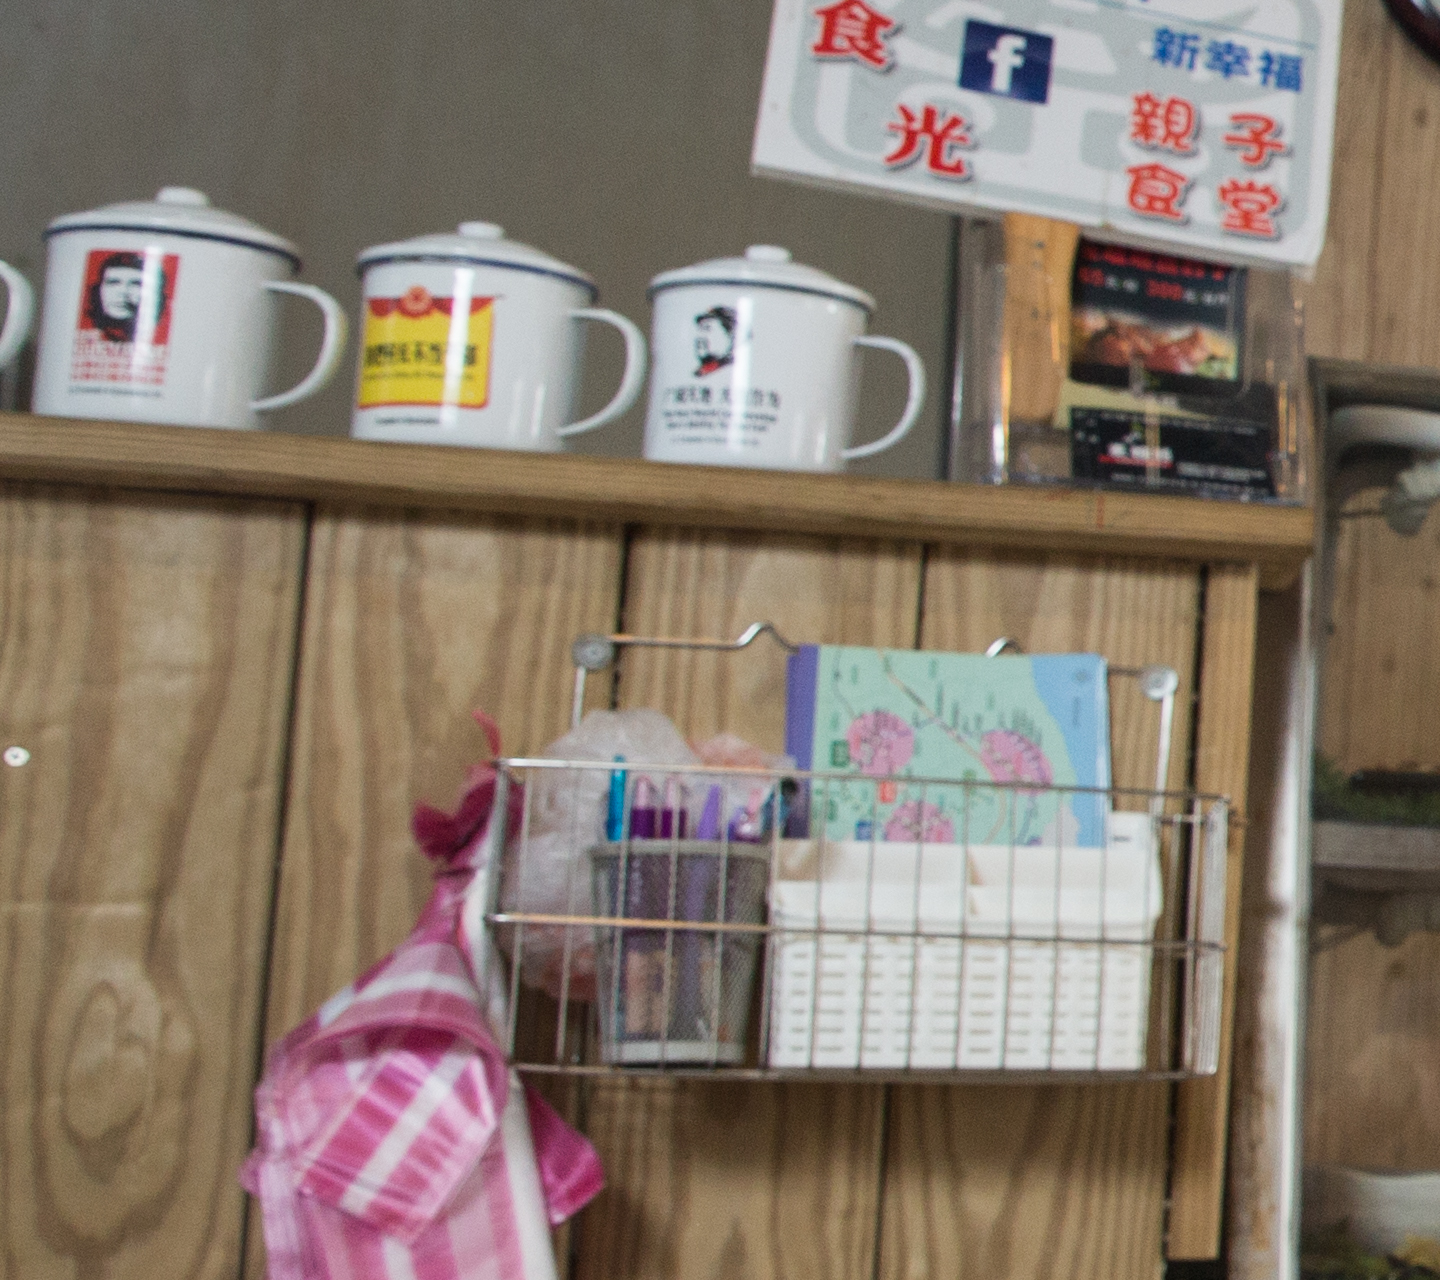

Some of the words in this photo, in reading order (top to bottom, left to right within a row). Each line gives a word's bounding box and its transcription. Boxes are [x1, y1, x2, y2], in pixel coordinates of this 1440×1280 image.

[1152, 25, 1305, 93] 新幸福
[1128, 92, 1286, 166] 親子
